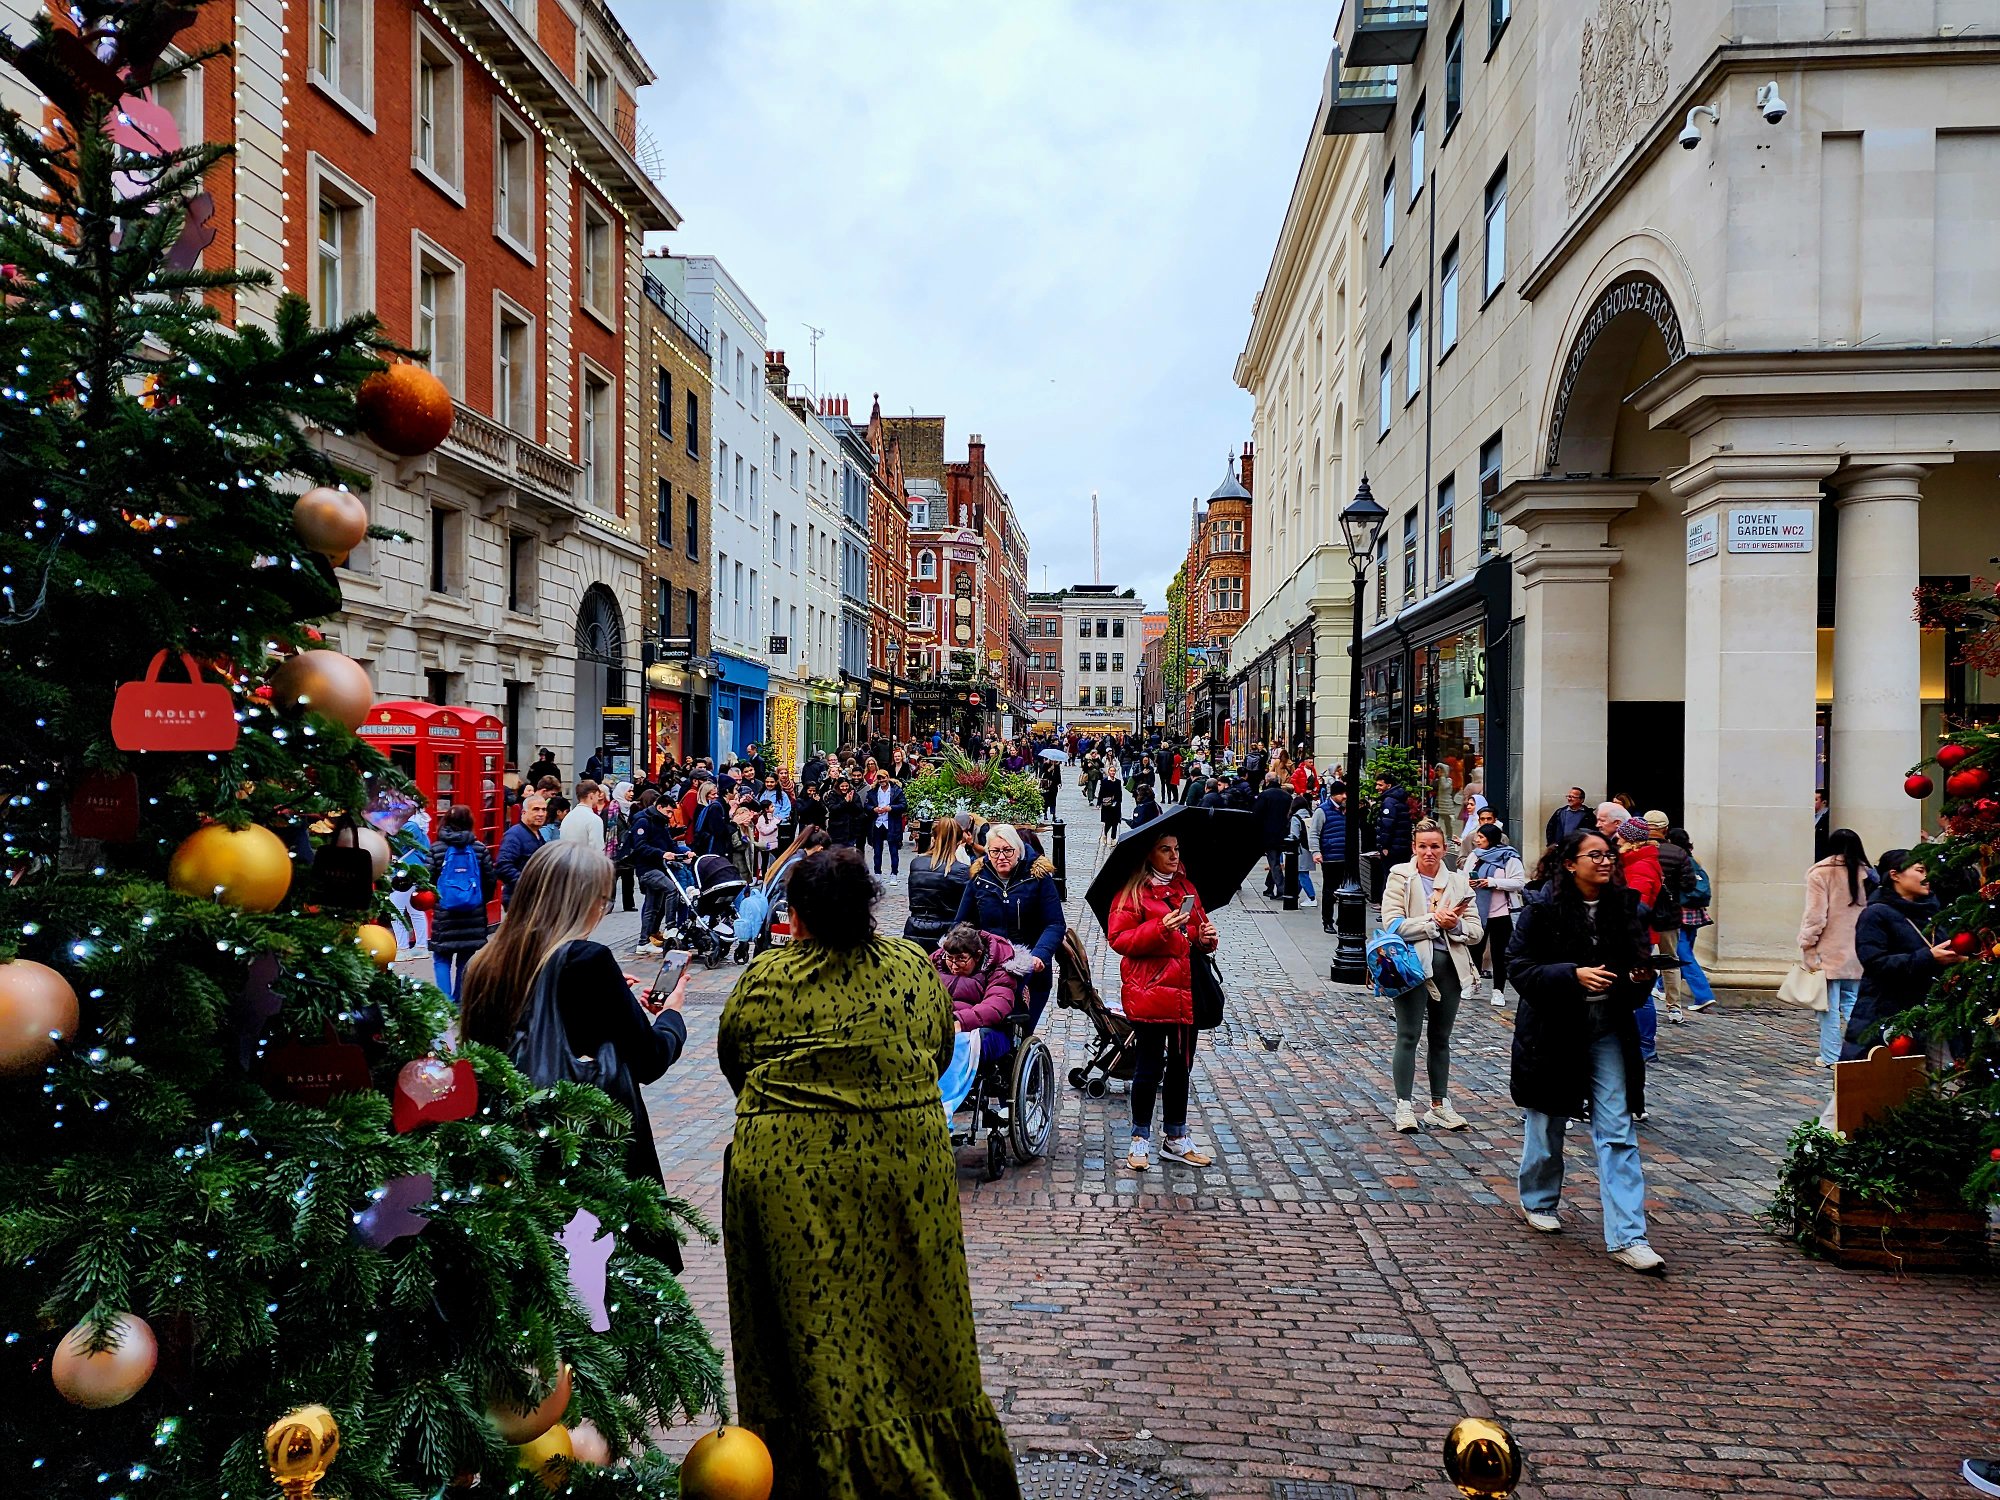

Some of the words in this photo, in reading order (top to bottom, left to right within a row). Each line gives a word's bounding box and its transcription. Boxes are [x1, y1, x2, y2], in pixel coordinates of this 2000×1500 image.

[1549, 370, 1578, 466] ROYAL
[1573, 310, 1604, 372] OPERA
[1604, 282, 1644, 323] HOUSE
[1738, 514, 1778, 525] COVENT
[1689, 524, 1703, 537] JAMES
[1737, 526, 1779, 536] GARDEN
[1782, 526, 1804, 536] WC2
[144, 709, 207, 718] RADLEY
[359, 725, 414, 735] TELEPHONE
[287, 1073, 343, 1083] RADLEY
